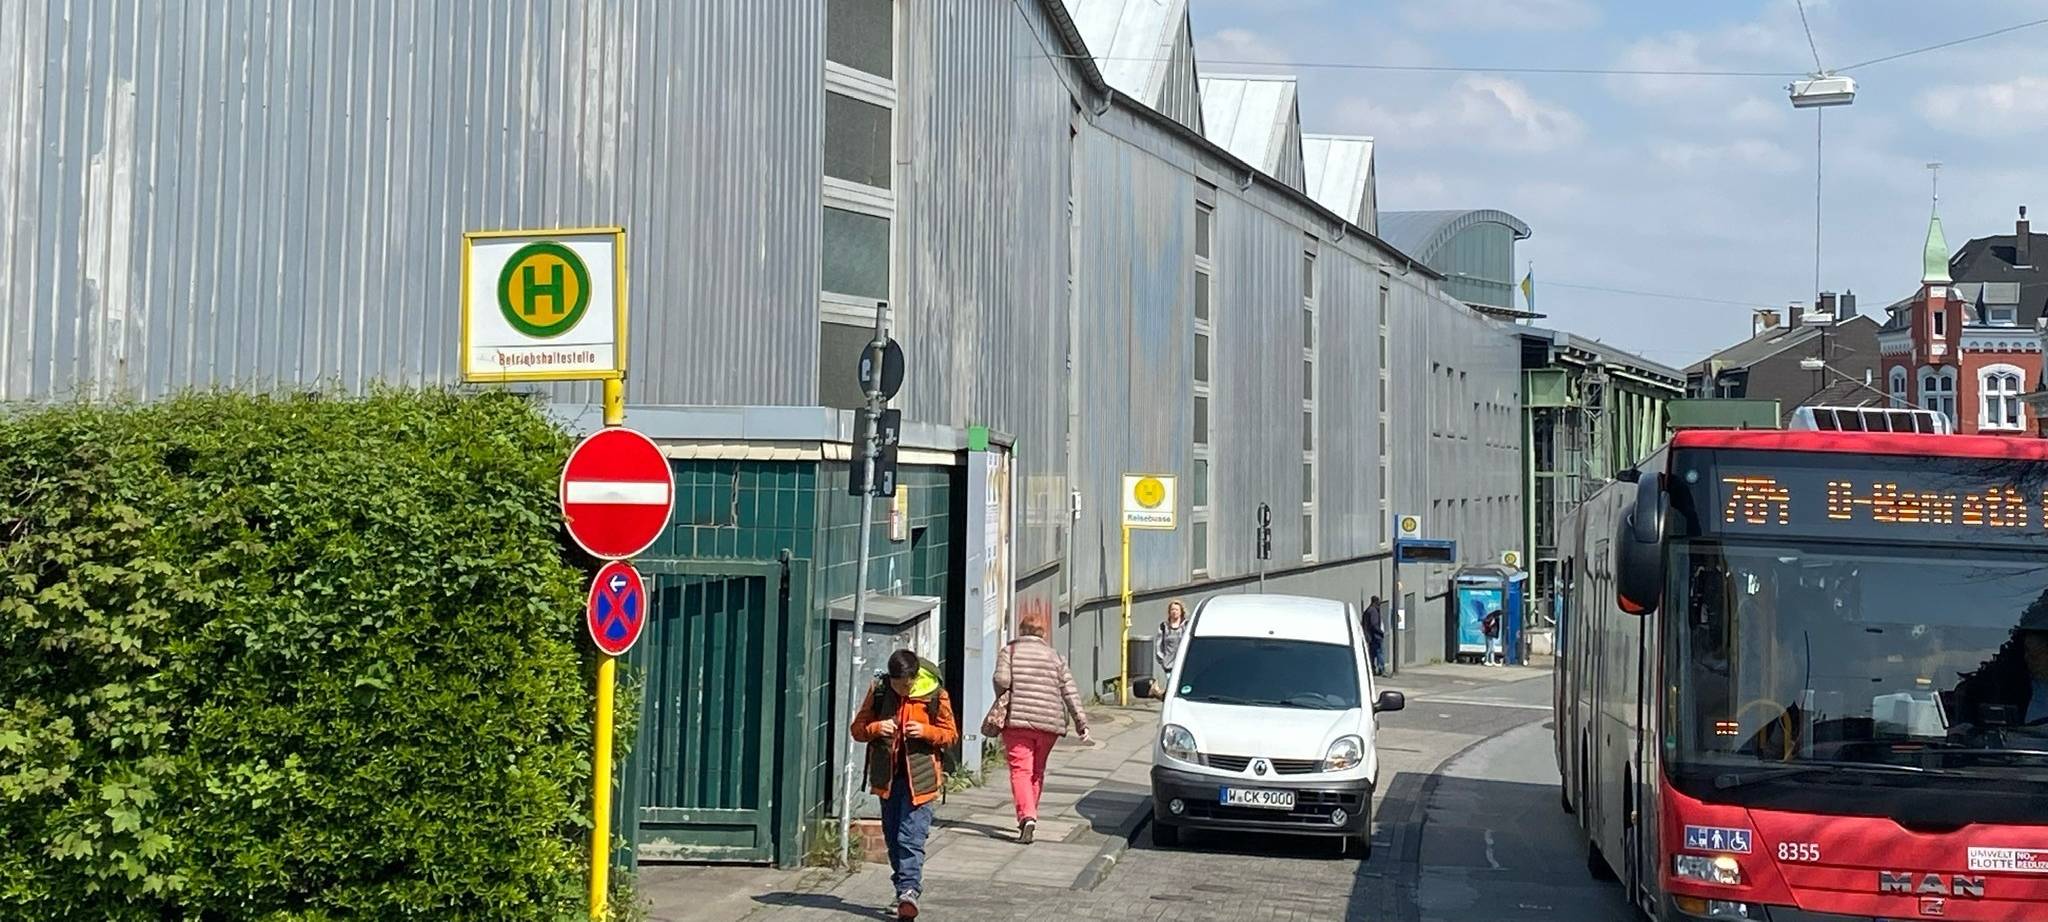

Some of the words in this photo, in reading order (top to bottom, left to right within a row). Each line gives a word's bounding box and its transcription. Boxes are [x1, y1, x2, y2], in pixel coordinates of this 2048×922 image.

[523, 264, 564, 315] H
[499, 352, 595, 366] Betriebshaltestelle
[1229, 790, 1237, 802] W
[1244, 790, 1260, 804] CK
[1263, 791, 1293, 806] 9000
[1777, 842, 1821, 862] 8355
[1970, 850, 2013, 859] UMWELT
[1970, 859, 2013, 869] FLOTTE
[1880, 870, 1986, 897] MAN
